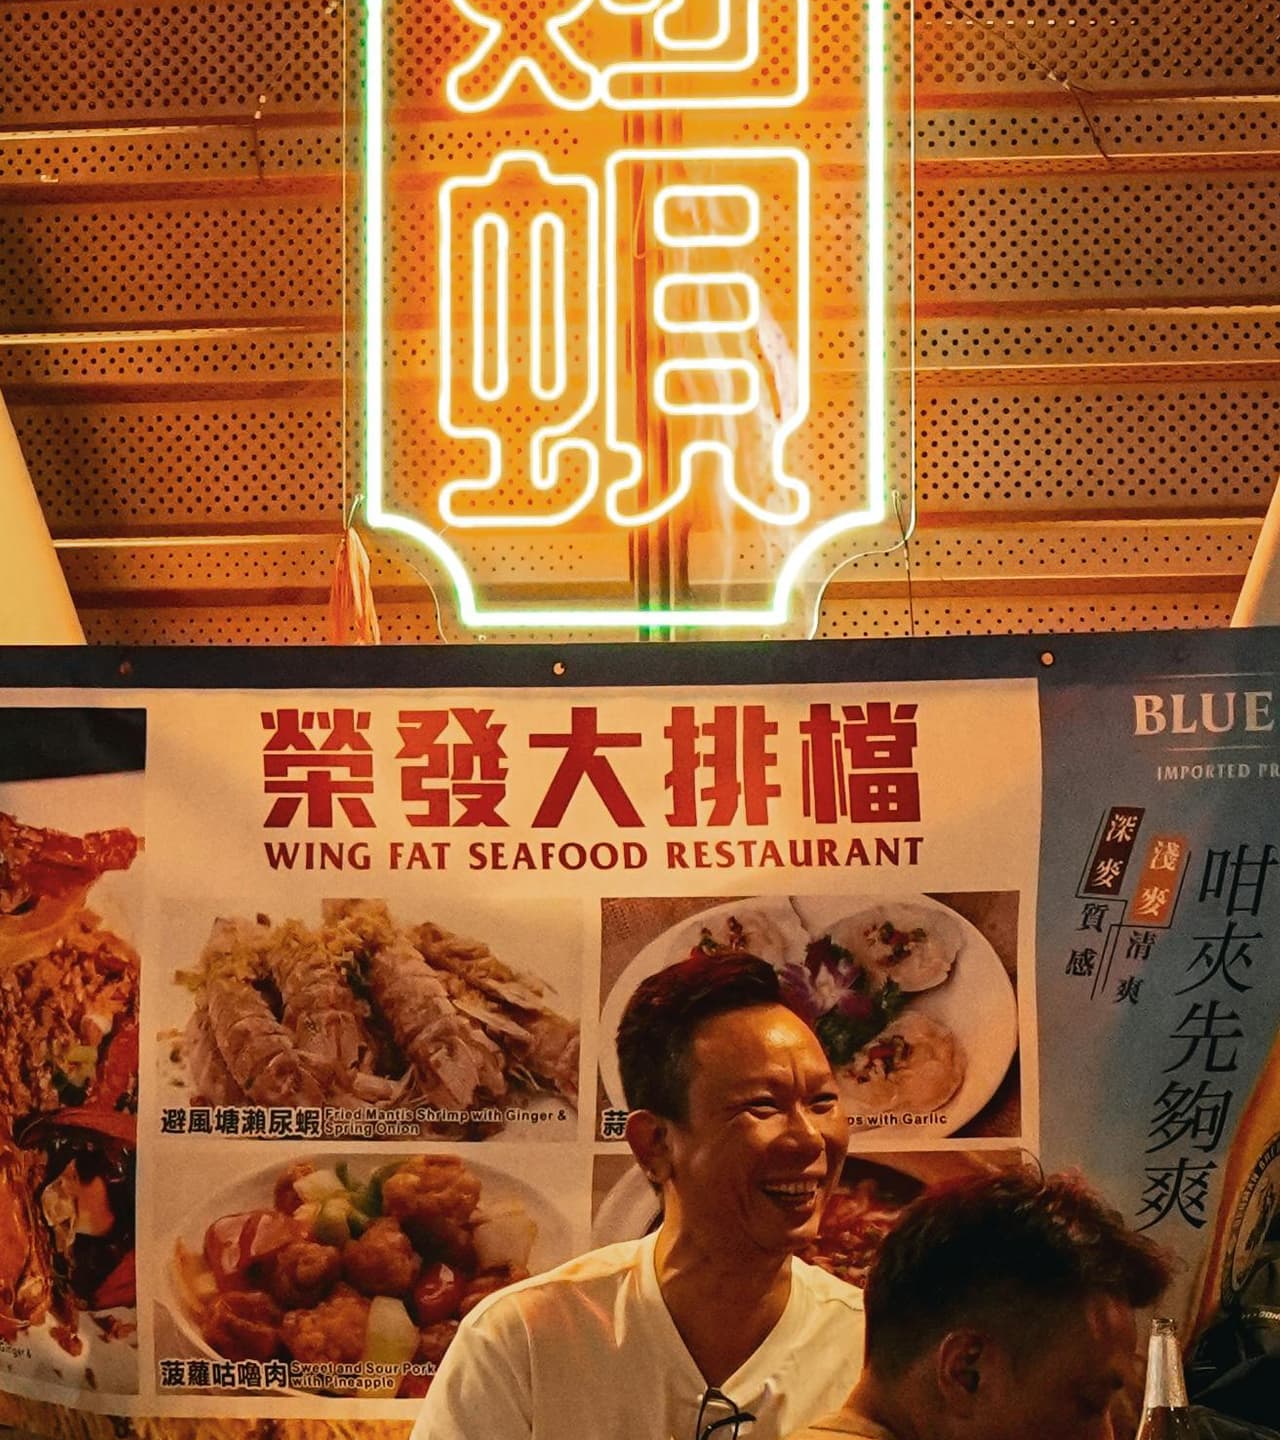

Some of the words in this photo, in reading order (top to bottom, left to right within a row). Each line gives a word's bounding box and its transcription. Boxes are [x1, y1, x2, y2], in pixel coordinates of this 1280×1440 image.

[1132, 690, 1274, 736] BLUE
[261, 703, 921, 828] 榮發大排檔
[1157, 762, 1251, 781] IMPORTED
[265, 841, 372, 871] WING
[389, 841, 450, 870] FAT
[469, 839, 648, 870] SEAFOOD
[666, 836, 924, 870] RESTAURANT
[1065, 813, 1139, 977] 深麥質感
[1135, 843, 1280, 1233] 咁夾先夠爽
[325, 1107, 362, 1121] Fried
[365, 1108, 416, 1121] Mantis
[417, 1108, 469, 1124] Shrimp
[471, 1109, 502, 1121] with
[505, 1109, 554, 1124] Ginger
[557, 1111, 567, 1121] &
[867, 1113, 898, 1126] with
[902, 1113, 948, 1125] Garlic
[325, 1122, 376, 1138] Spring
[377, 1122, 420, 1136] Onion
[160, 1359, 288, 1388] 菠蘿咕嚕肉
[291, 1361, 334, 1374] Sweet
[337, 1362, 362, 1374] and
[365, 1362, 400, 1374] Sour
[404, 1362, 437, 1375] Pork
[291, 1375, 321, 1387] with
[324, 1375, 395, 1390] Pineapple
